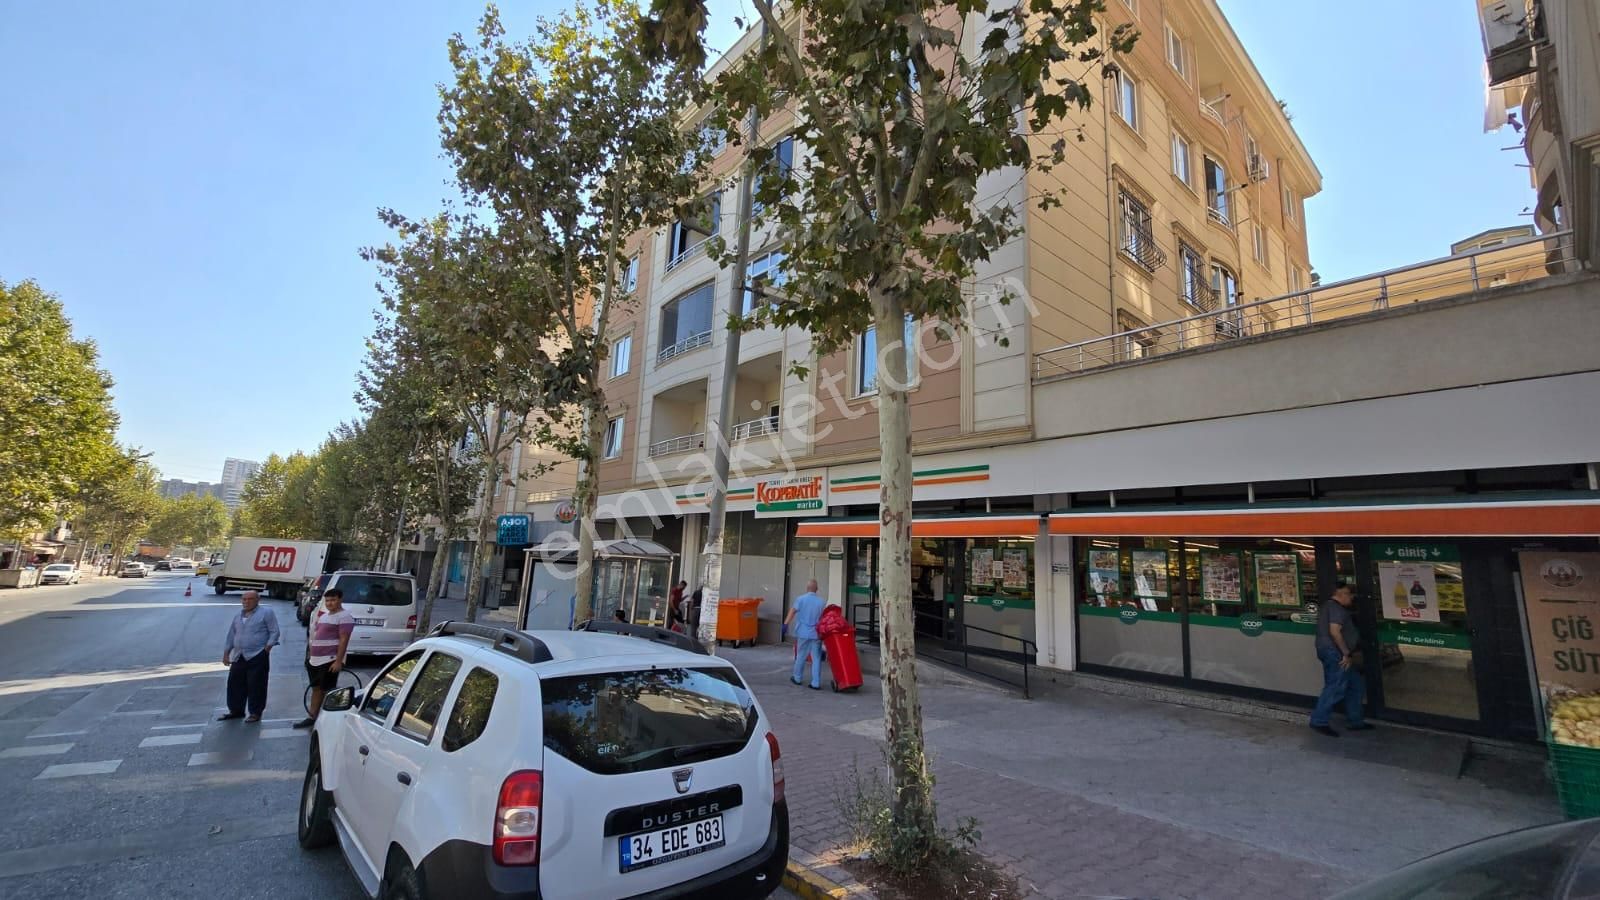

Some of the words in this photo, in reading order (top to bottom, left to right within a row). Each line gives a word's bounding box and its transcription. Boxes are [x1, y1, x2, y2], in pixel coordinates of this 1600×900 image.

[796, 501, 818, 509] market
[1398, 547, 1427, 560] GİRİŞ
[1552, 615, 1594, 643] ÇİĞ
[642, 803, 720, 829] DUSTER
[633, 836, 653, 861] 34
[662, 827, 690, 854] EDE
[696, 819, 720, 844] 683
